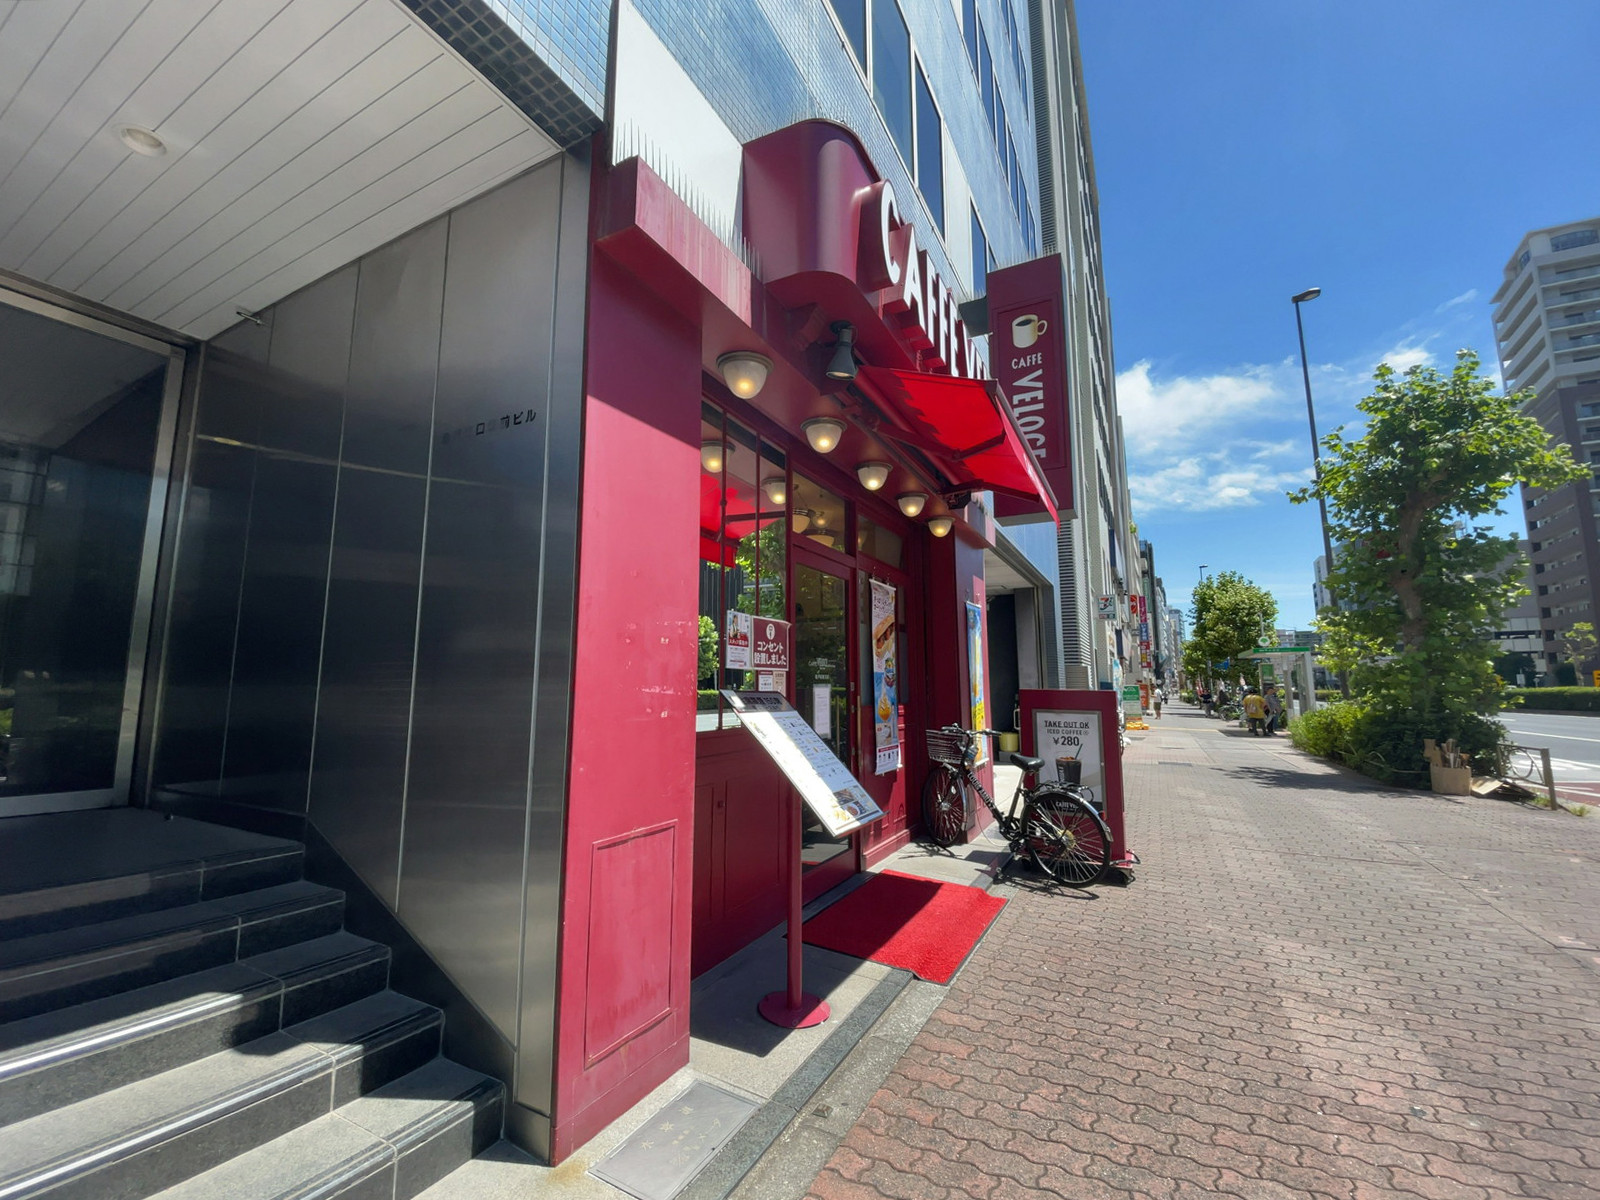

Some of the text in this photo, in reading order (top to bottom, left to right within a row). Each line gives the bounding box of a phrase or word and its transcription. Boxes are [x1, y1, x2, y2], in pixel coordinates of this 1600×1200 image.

[881, 179, 959, 378] CAFFE
[1012, 353, 1042, 369] CAFFE
[757, 641, 784, 653] コンセント
[754, 652, 787, 665] 設置しました
[1044, 720, 1062, 728] TAKE
[1080, 721, 1090, 729] OK
